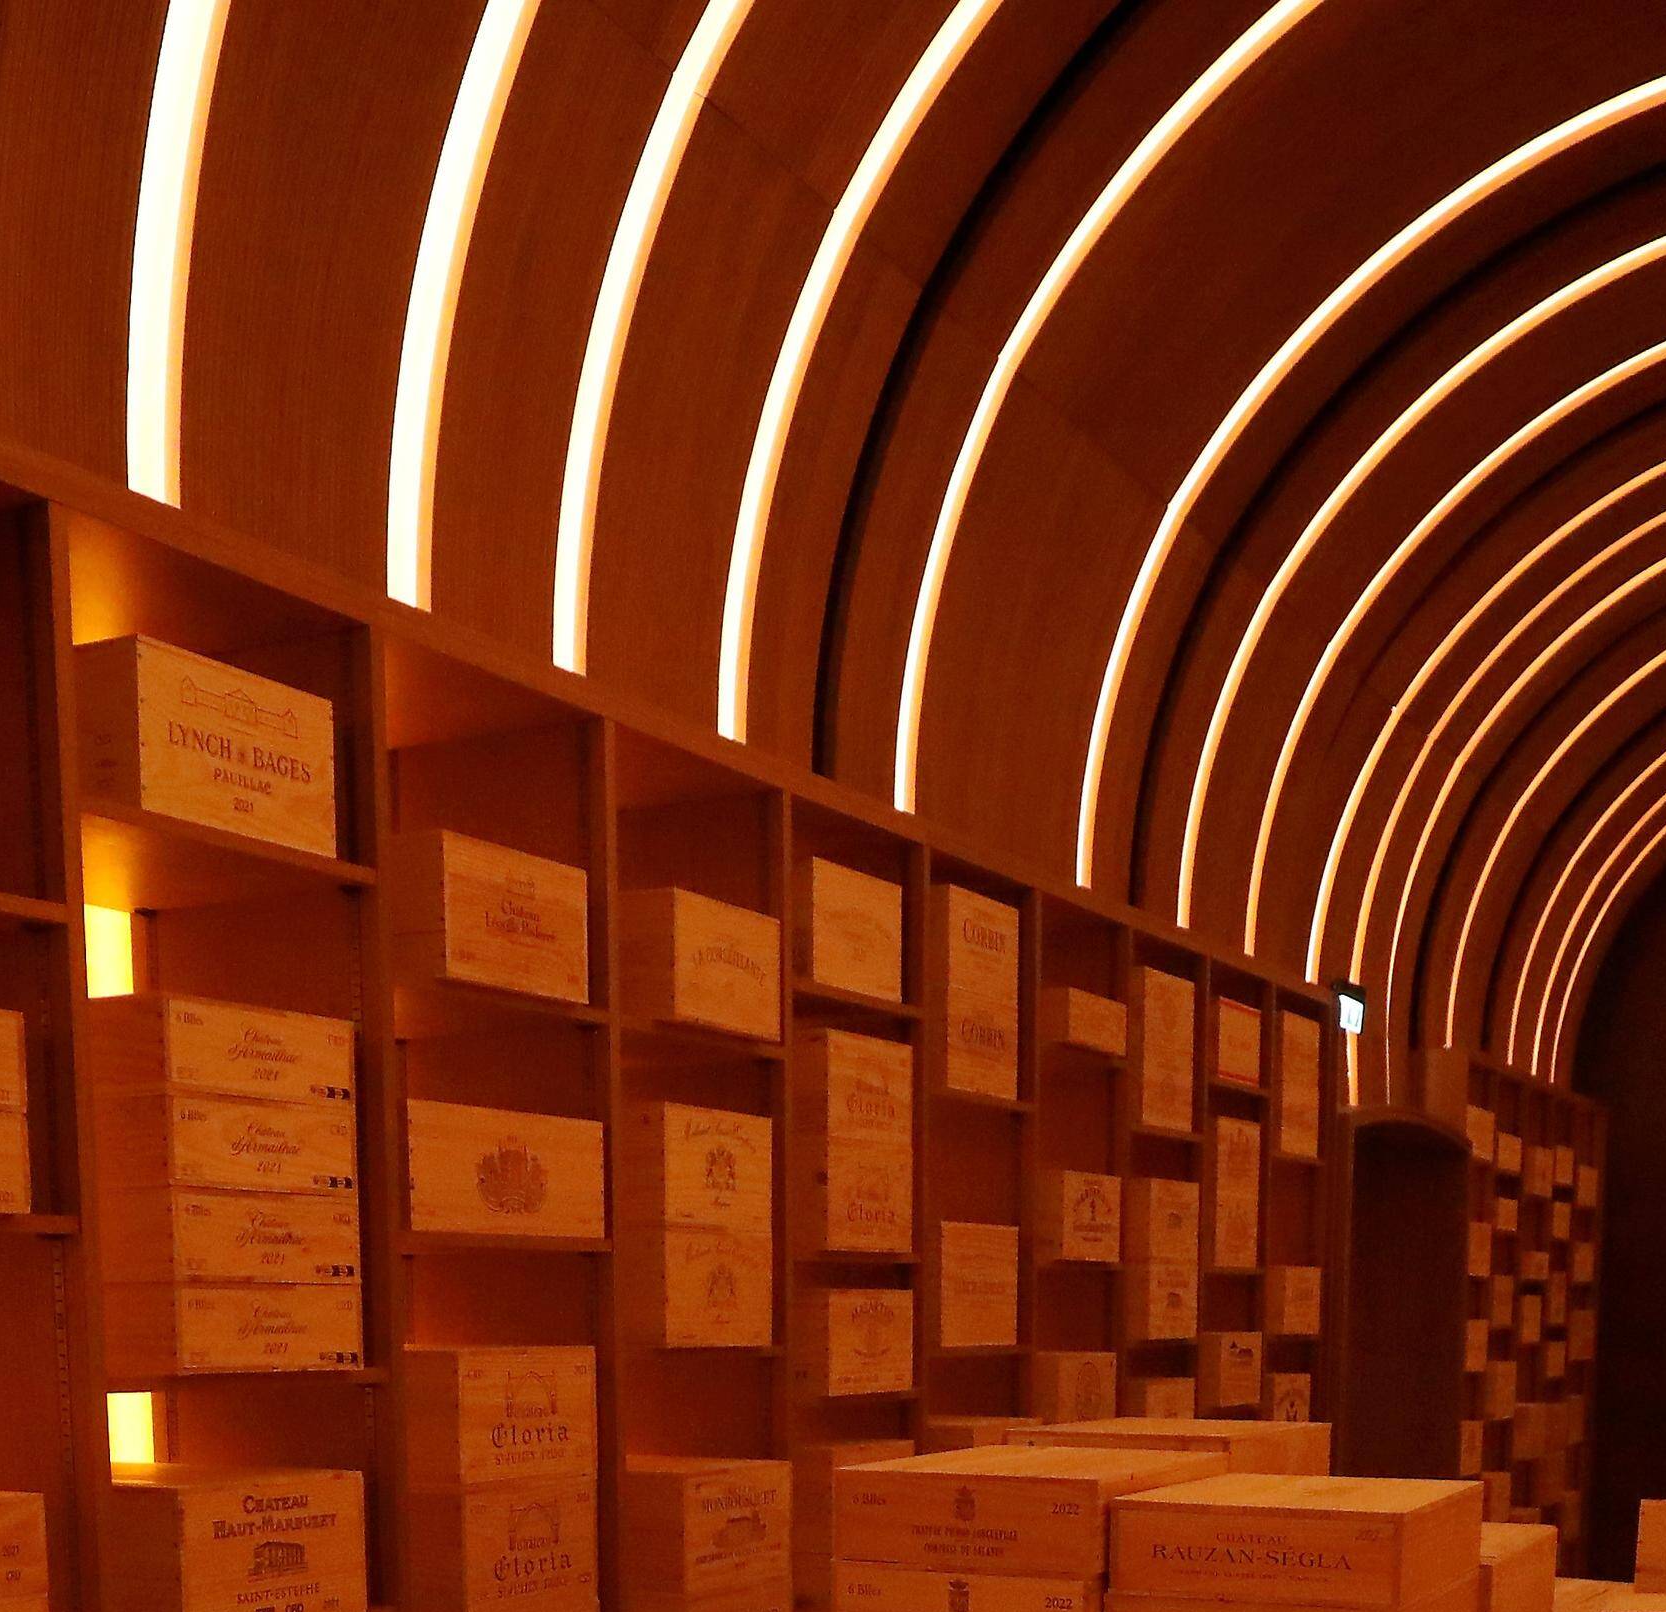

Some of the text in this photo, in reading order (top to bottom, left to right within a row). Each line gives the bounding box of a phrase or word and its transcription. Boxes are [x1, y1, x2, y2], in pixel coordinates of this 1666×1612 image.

[167, 720, 312, 786] LYNCH BAGES
[489, 1421, 571, 1450] Gloria
[1150, 1541, 1353, 1573] RAUZAN-SÉGLA
[1044, 1596, 1074, 1610] 2022
